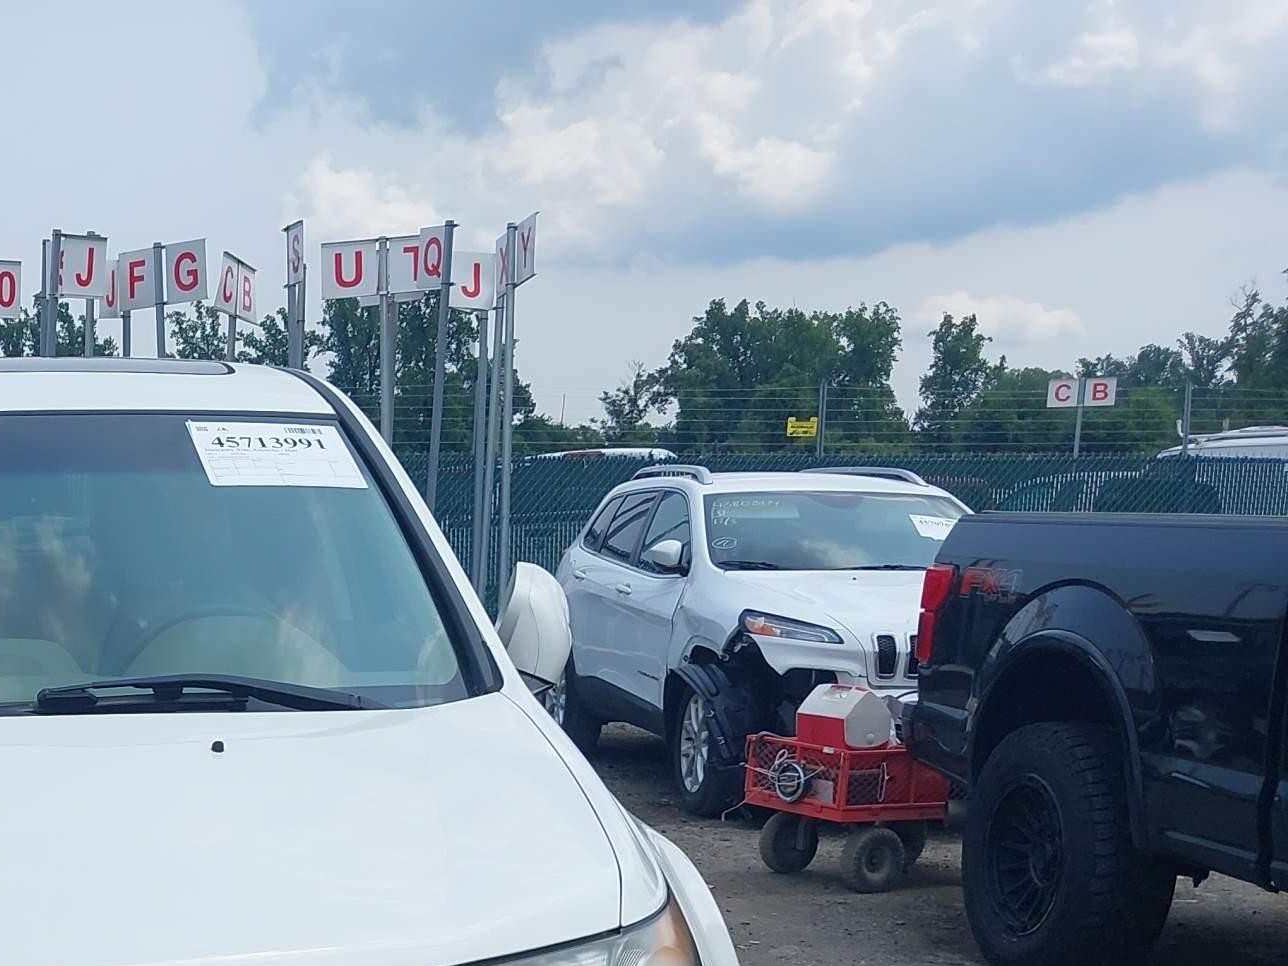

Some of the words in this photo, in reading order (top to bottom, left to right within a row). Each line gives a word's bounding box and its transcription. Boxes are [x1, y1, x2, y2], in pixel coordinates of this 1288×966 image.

[292, 234, 300, 274] S
[423, 236, 442, 278] Q
[520, 226, 532, 269] Y
[75, 247, 94, 287] J
[128, 259, 145, 299] F
[174, 252, 199, 292] G
[223, 266, 234, 304] C
[334, 250, 362, 288] U
[461, 262, 480, 298] J
[243, 276, 252, 312] B
[1054, 384, 1072, 402] C
[1092, 383, 1109, 401] B
[211, 436, 327, 450] 45713991
